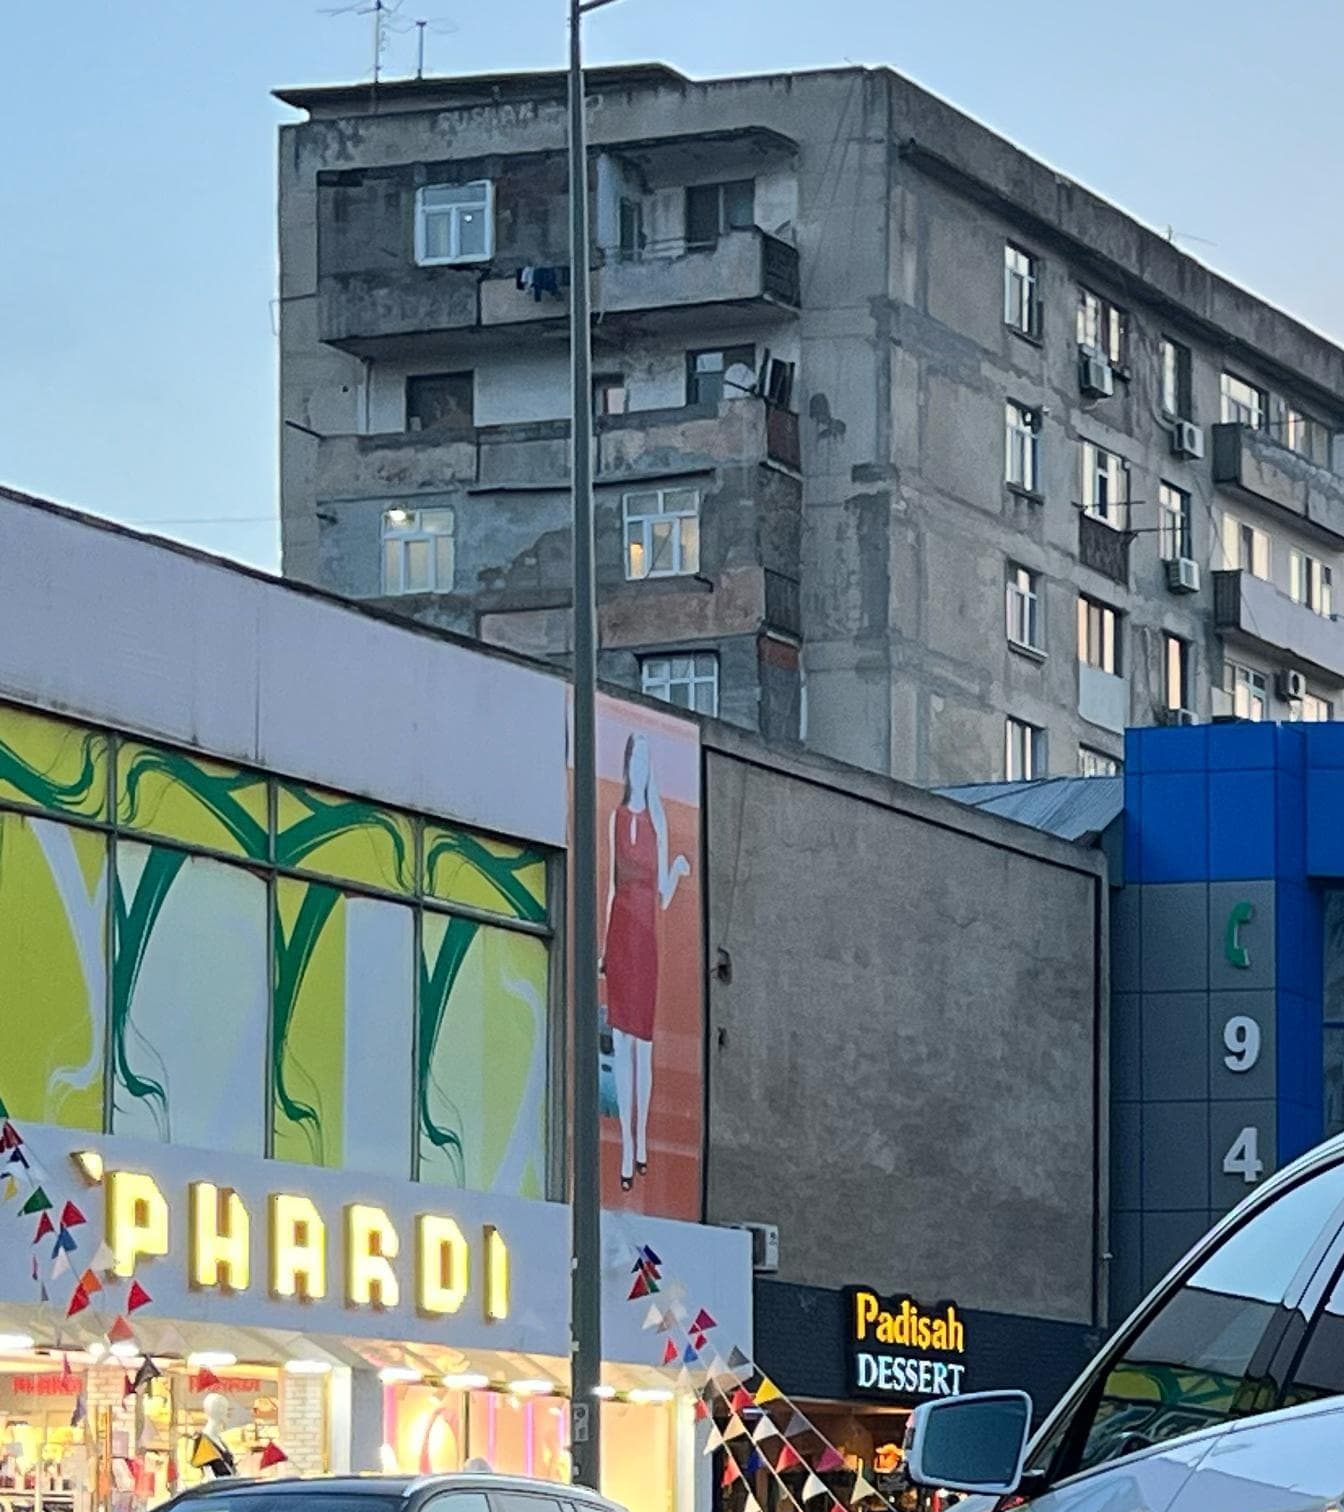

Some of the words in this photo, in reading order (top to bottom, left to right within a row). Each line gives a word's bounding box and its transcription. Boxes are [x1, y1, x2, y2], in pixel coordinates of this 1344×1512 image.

[1223, 1015, 1261, 1072] 9
[1223, 1126, 1263, 1182] 4
[857, 1353, 965, 1396] DESSERT
